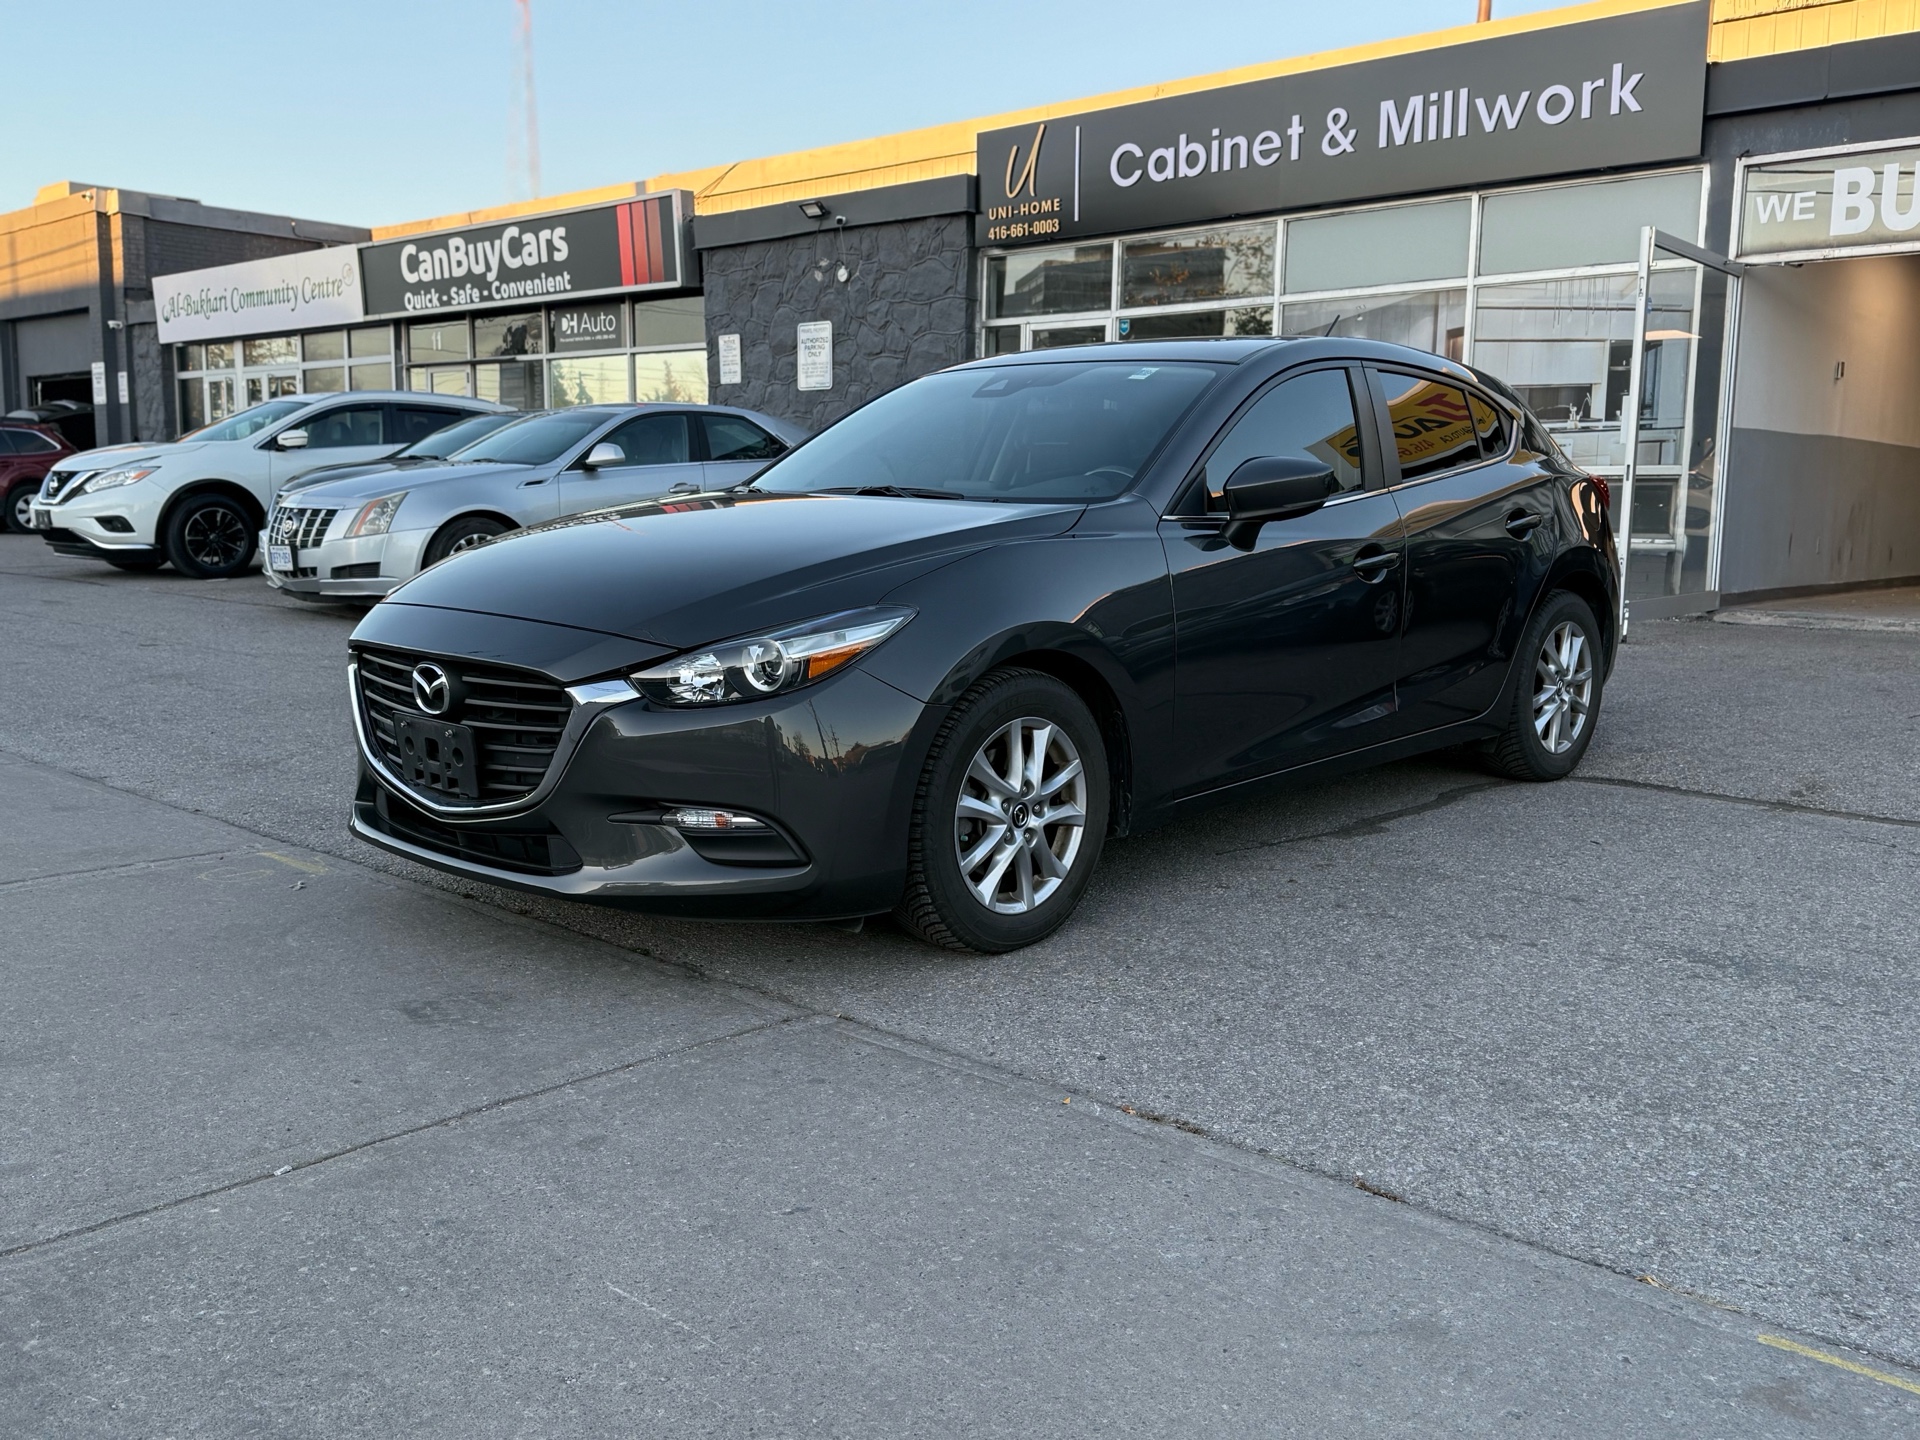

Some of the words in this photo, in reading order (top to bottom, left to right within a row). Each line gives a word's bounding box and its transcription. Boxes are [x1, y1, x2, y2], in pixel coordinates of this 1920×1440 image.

[1110, 114, 1304, 187] Cabinet
[1321, 107, 1358, 156] &
[1379, 63, 1644, 148] Millwork
[988, 198, 1060, 220] UNI-HOME
[1756, 191, 1817, 224] WE
[988, 218, 1060, 240] 416-661-0003
[401, 226, 569, 283] CanBuyCars
[163, 288, 229, 321] Al-Bukhari
[231, 280, 298, 311] Community
[302, 276, 343, 304] Centre
[404, 288, 440, 311] Quick
[450, 283, 480, 305] Safe
[491, 271, 571, 300] Convenient
[580, 312, 616, 332] Auto
[431, 331, 441, 351] 11
[808, 350, 821, 358] ONLY
